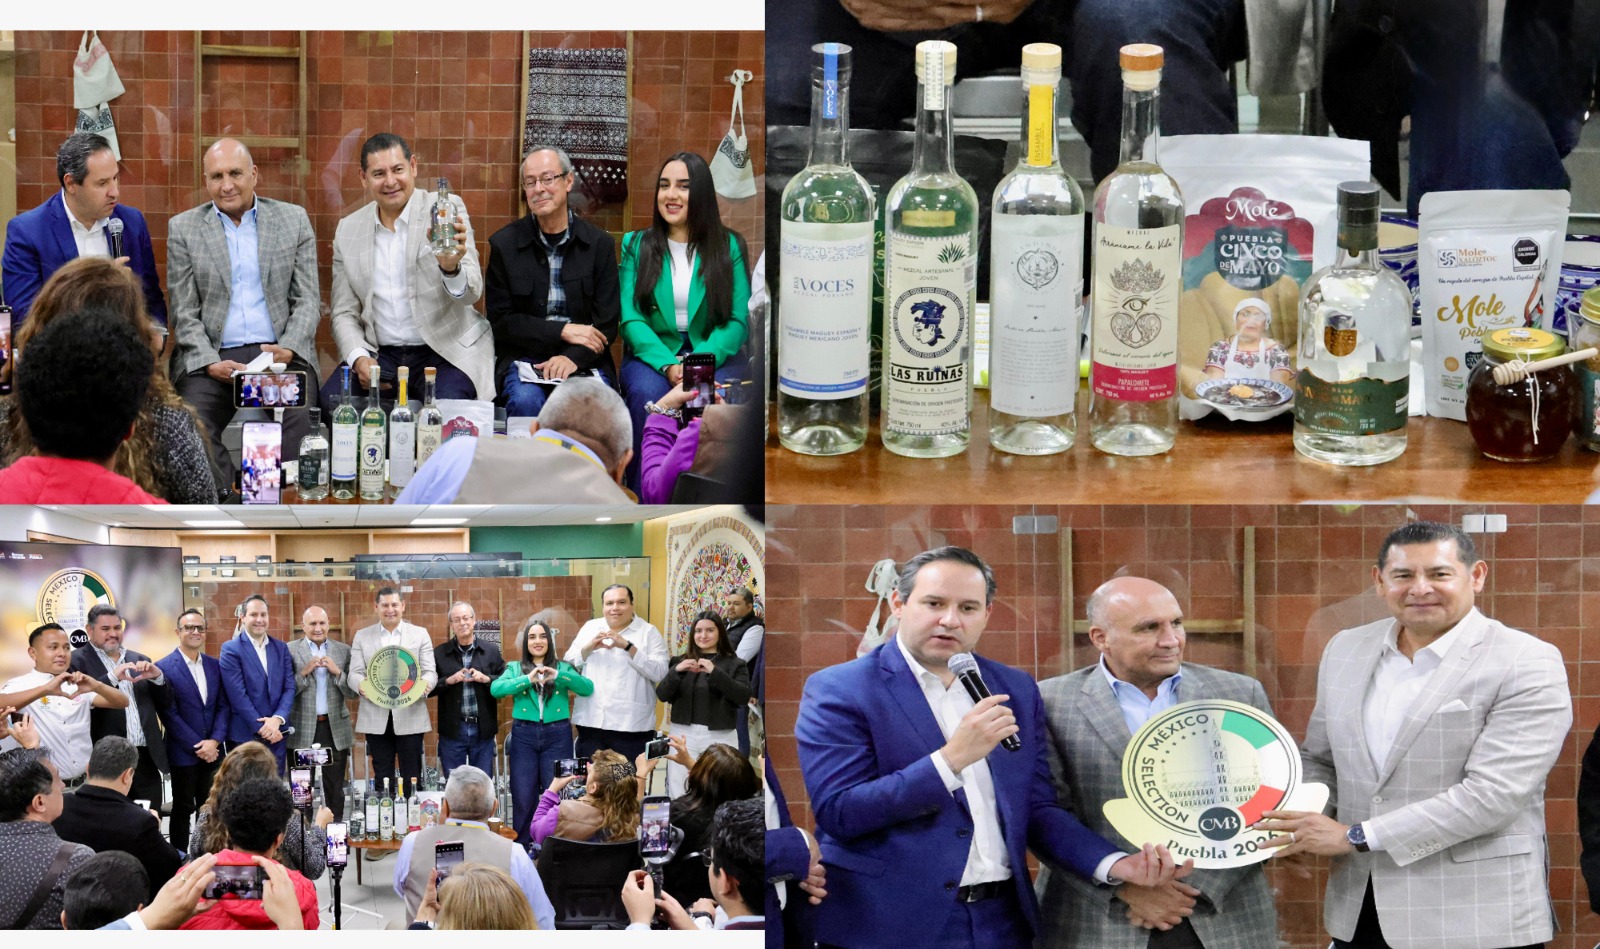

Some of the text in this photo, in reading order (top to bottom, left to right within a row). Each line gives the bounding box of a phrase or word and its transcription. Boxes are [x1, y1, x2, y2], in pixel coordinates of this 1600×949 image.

[826, 79, 835, 116] VOCES
[1034, 126, 1042, 162] ENSAMBLE
[1225, 198, 1279, 222] Mole
[873, 230, 886, 245] Ca
[1144, 240, 1156, 250] la
[1157, 237, 1173, 250] Vida
[1229, 234, 1274, 243] PUEBLA
[1220, 243, 1282, 260] CINCO
[1459, 248, 1480, 257] Mole
[1220, 260, 1280, 275] DE MAYO
[800, 278, 855, 293] VOCES
[1437, 293, 1506, 329] Mole
[1459, 325, 1488, 341] Pobl
[891, 366, 911, 380] LAS
[917, 367, 963, 382] RUINAS
[45, 597, 54, 623] SELEC
[70, 634, 88, 643] CMB
[373, 665, 386, 692] SELECTION
[377, 696, 412, 706] Puebla 2026
[1148, 714, 1209, 751] MÉXICO
[1141, 756, 1190, 823] SELECTION
[1200, 816, 1239, 831] CMB
[1166, 839, 1227, 859] Puebla
